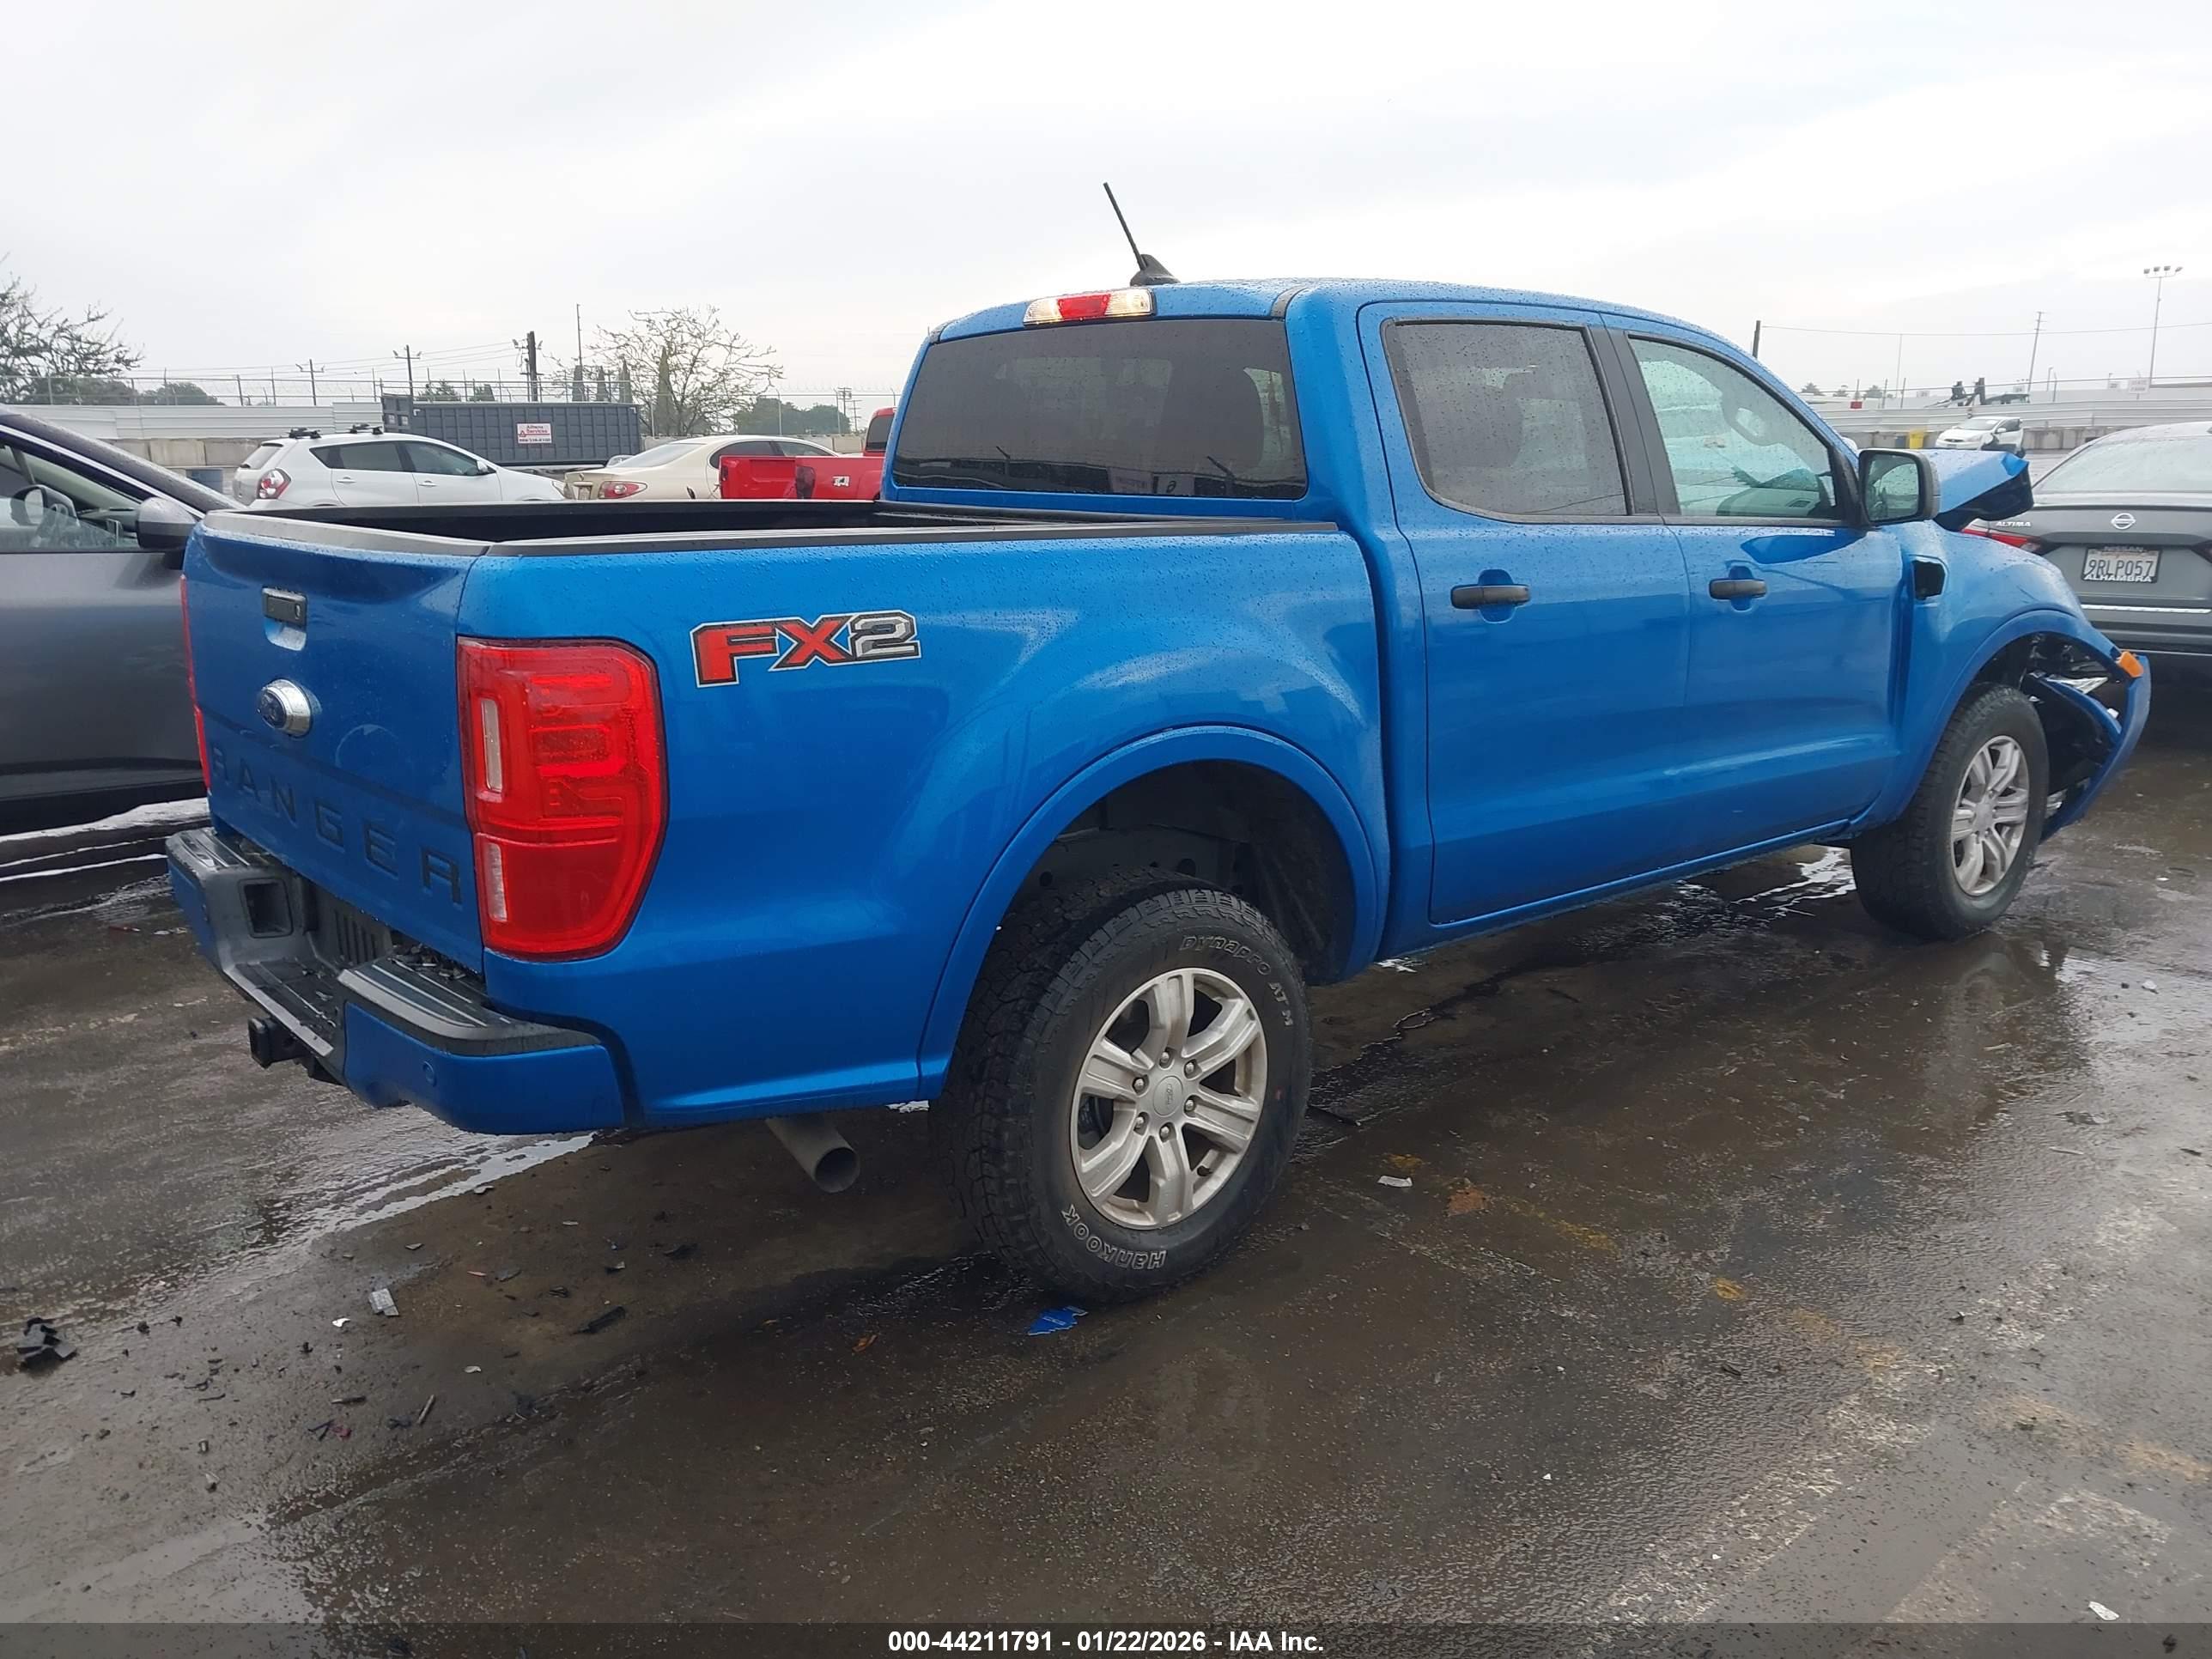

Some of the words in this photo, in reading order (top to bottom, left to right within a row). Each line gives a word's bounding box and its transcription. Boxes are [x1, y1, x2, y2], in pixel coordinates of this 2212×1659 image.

[2084, 559, 2154, 578] 9RLP057
[690, 610, 921, 687] FX2
[211, 745, 463, 910] RANGER
